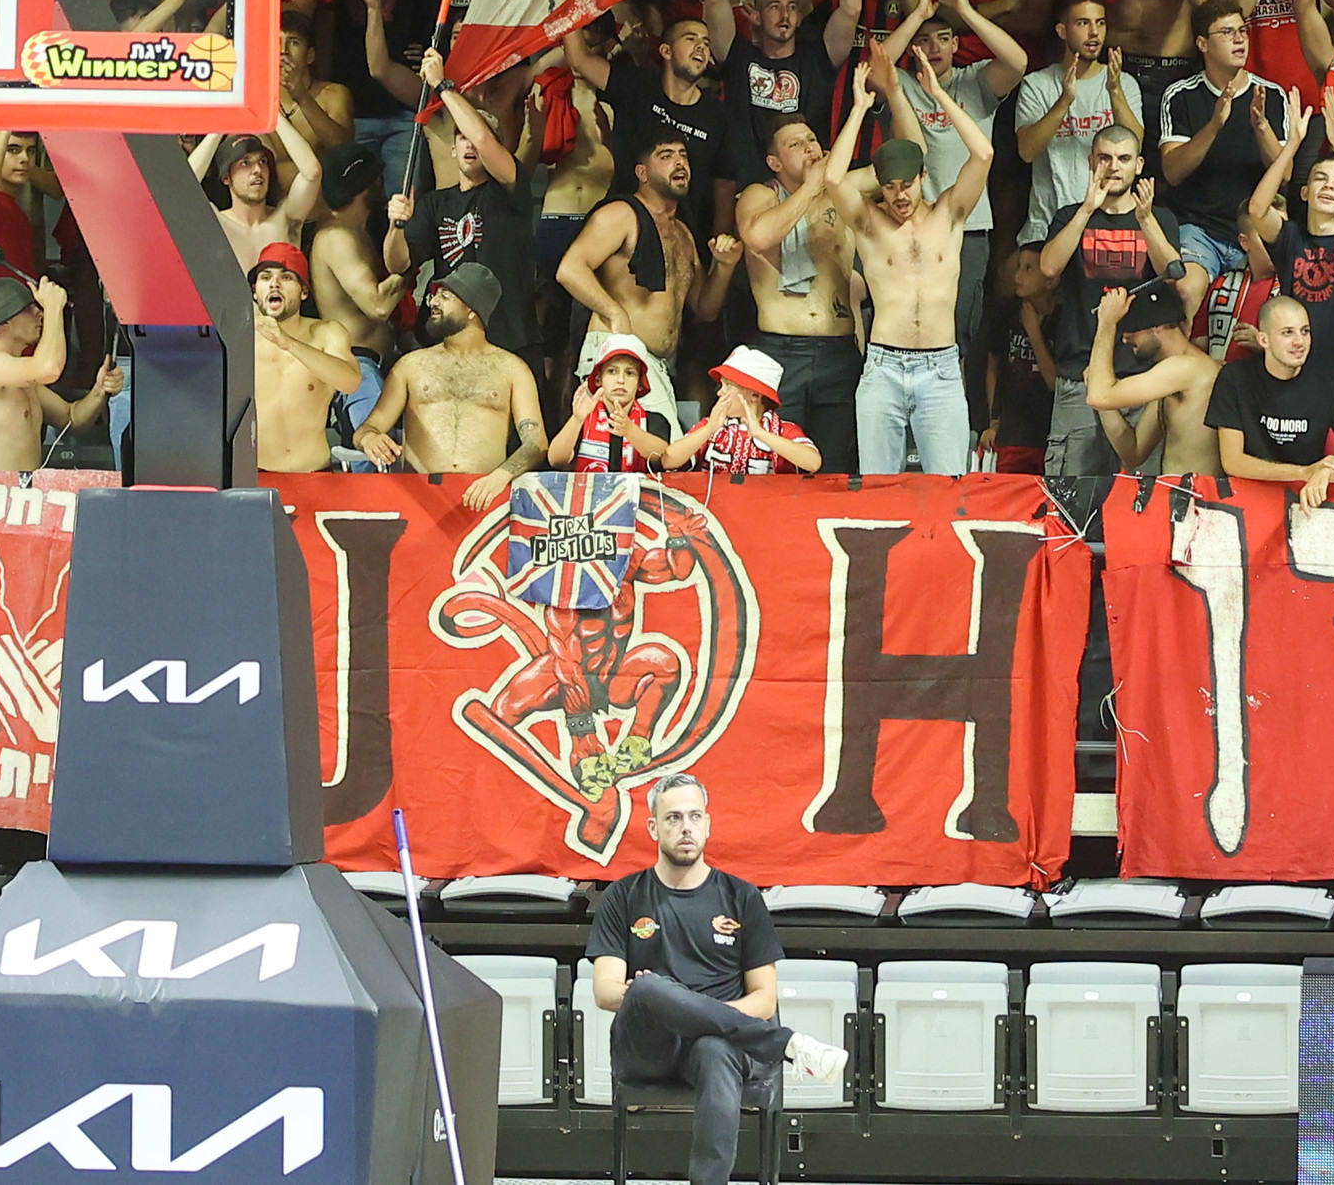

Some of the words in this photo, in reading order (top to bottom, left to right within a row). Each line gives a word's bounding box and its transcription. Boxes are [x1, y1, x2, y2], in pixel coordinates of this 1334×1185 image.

[129, 41, 175, 63] ליגת
[179, 55, 214, 82] סל
[1280, 418, 1308, 433] MORO
[83, 658, 261, 706] KIA
[0, 917, 301, 982] KIA
